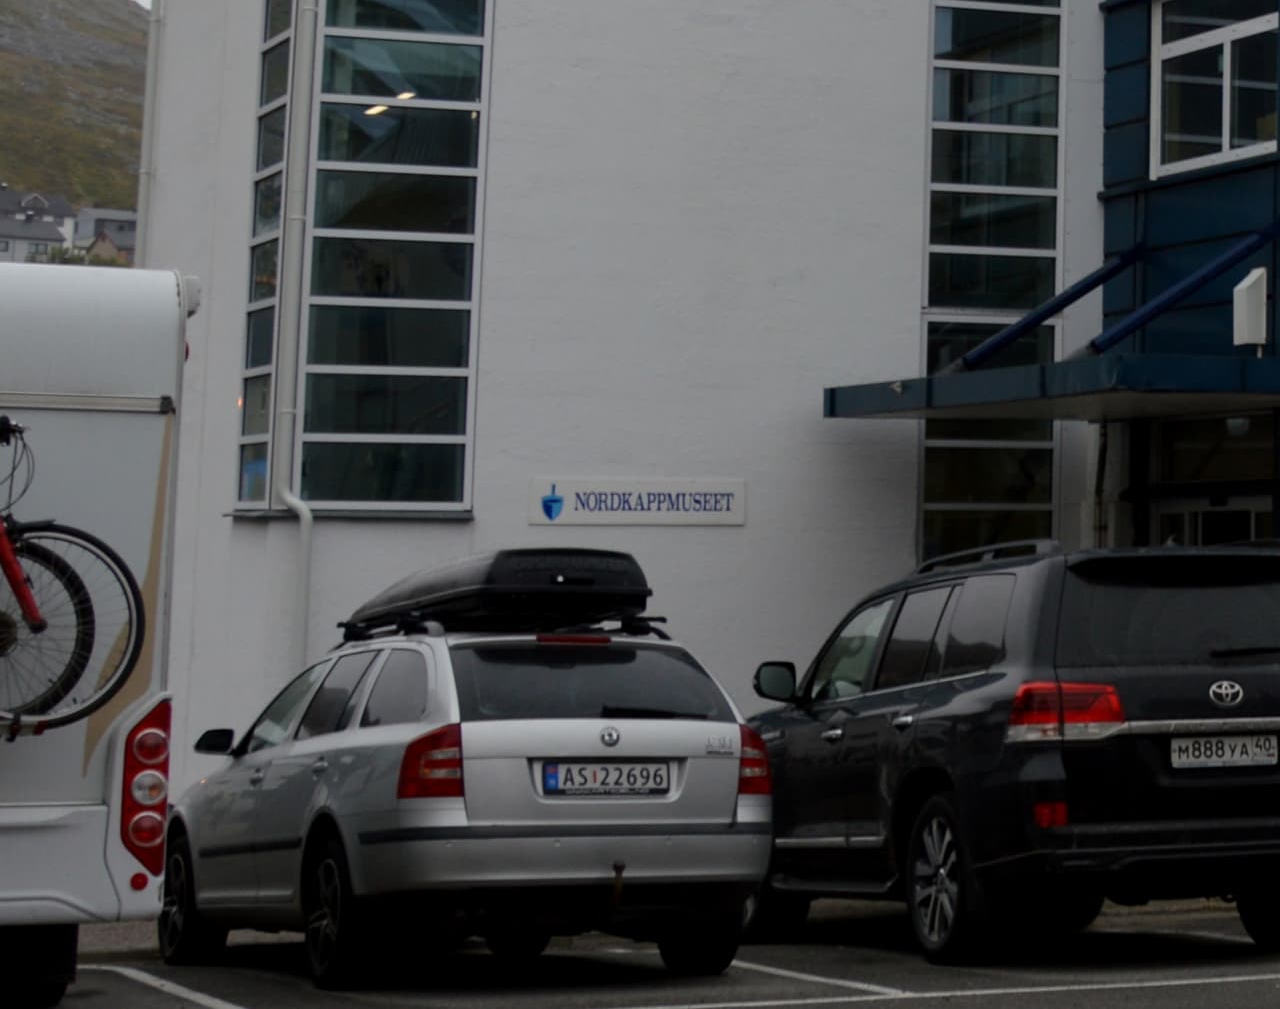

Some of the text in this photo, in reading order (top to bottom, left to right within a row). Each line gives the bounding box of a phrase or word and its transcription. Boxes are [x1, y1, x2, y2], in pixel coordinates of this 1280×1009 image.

[574, 492, 735, 512] NORDKAPPMUSEET
[563, 767, 664, 786] AS 22696
